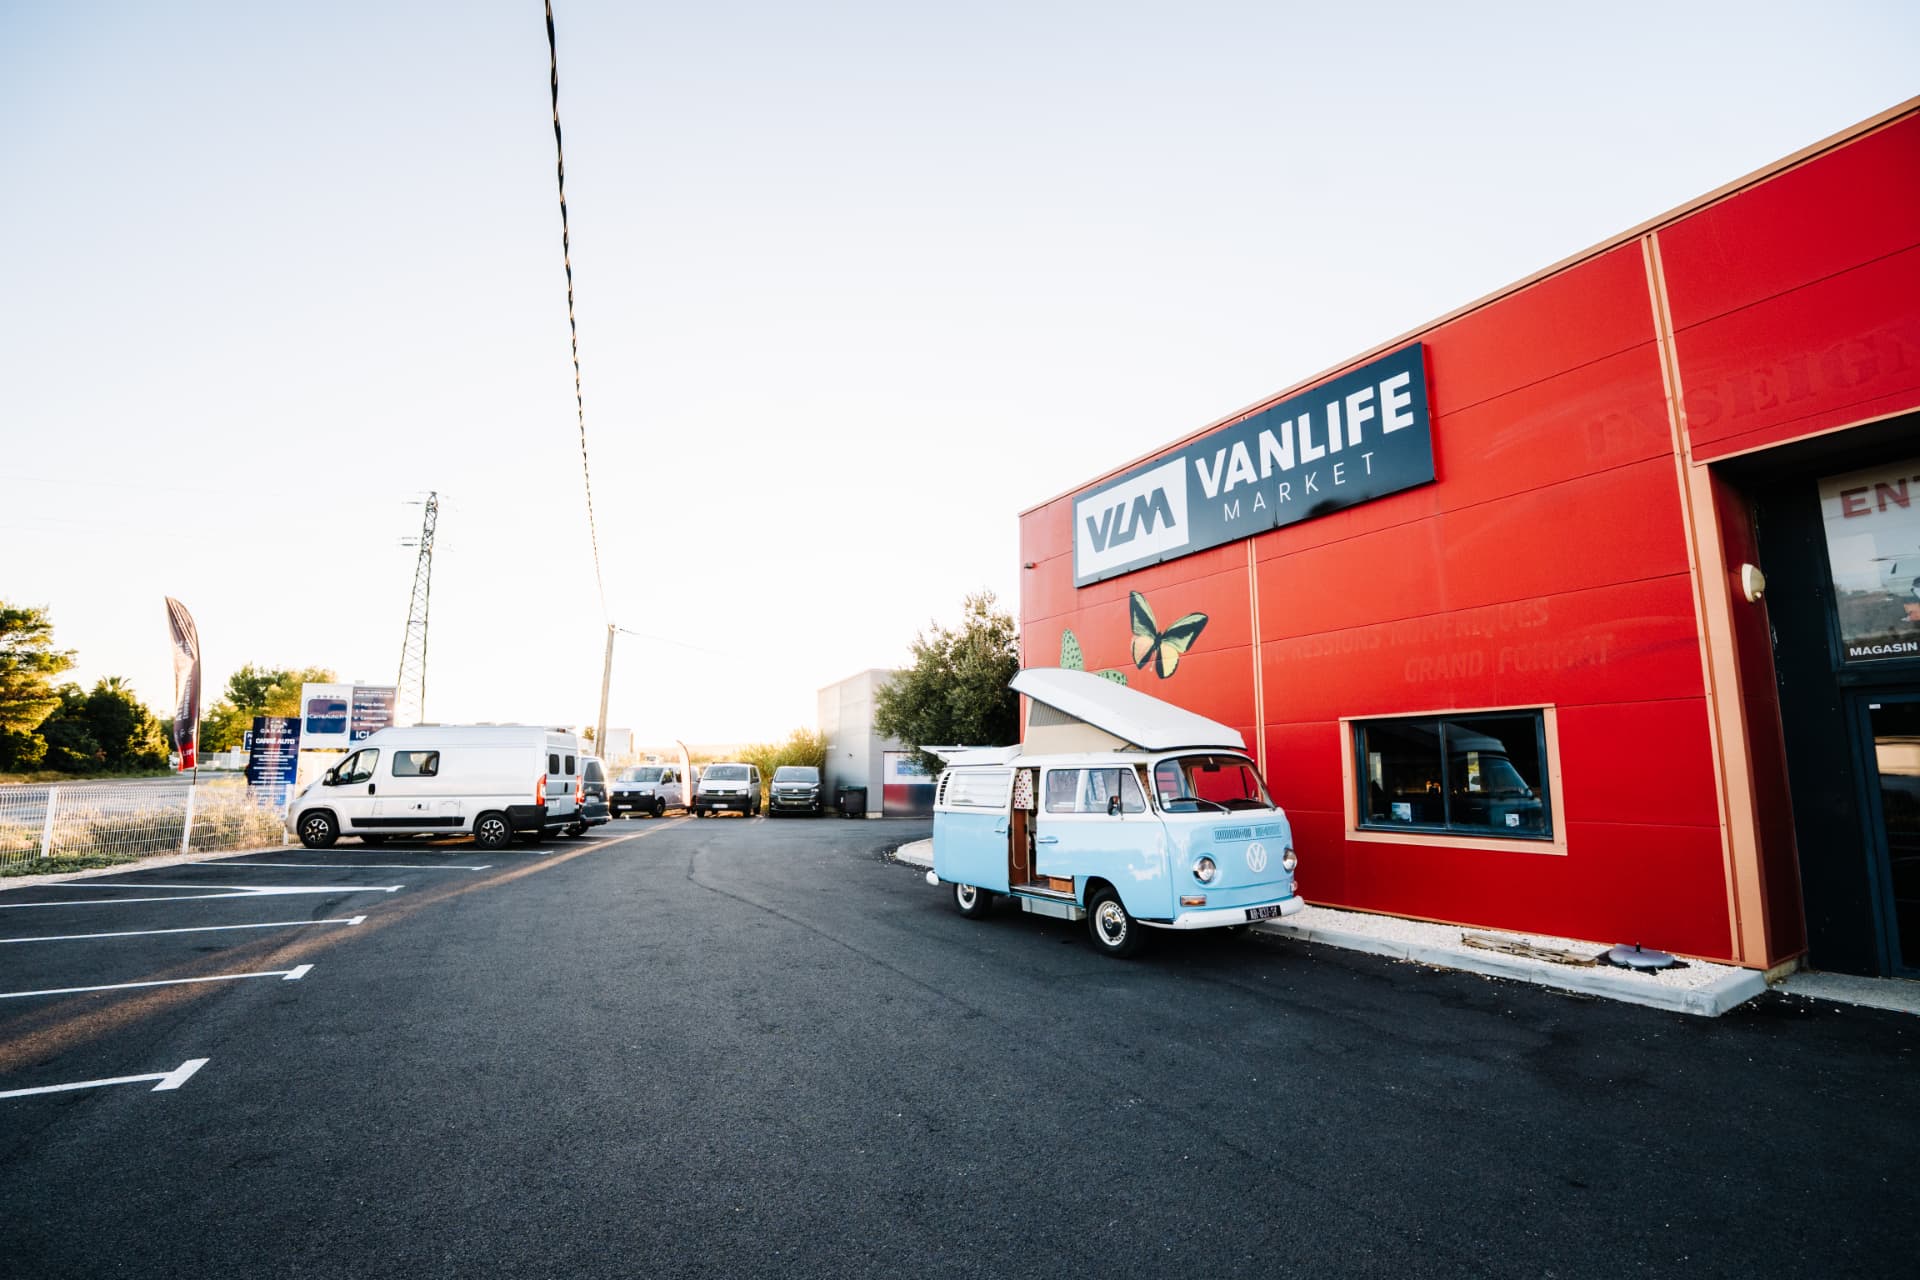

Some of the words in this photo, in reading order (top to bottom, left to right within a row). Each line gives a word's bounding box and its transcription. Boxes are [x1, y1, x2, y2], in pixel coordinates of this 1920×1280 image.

[1195, 371, 1414, 499] VANLIFE
[1223, 451, 1375, 522] MARKET
[1840, 475, 1920, 519] EN
[1085, 487, 1177, 553] VLM
[1404, 649, 1483, 683] GRAND
[1849, 641, 1919, 657] MAGASIN
